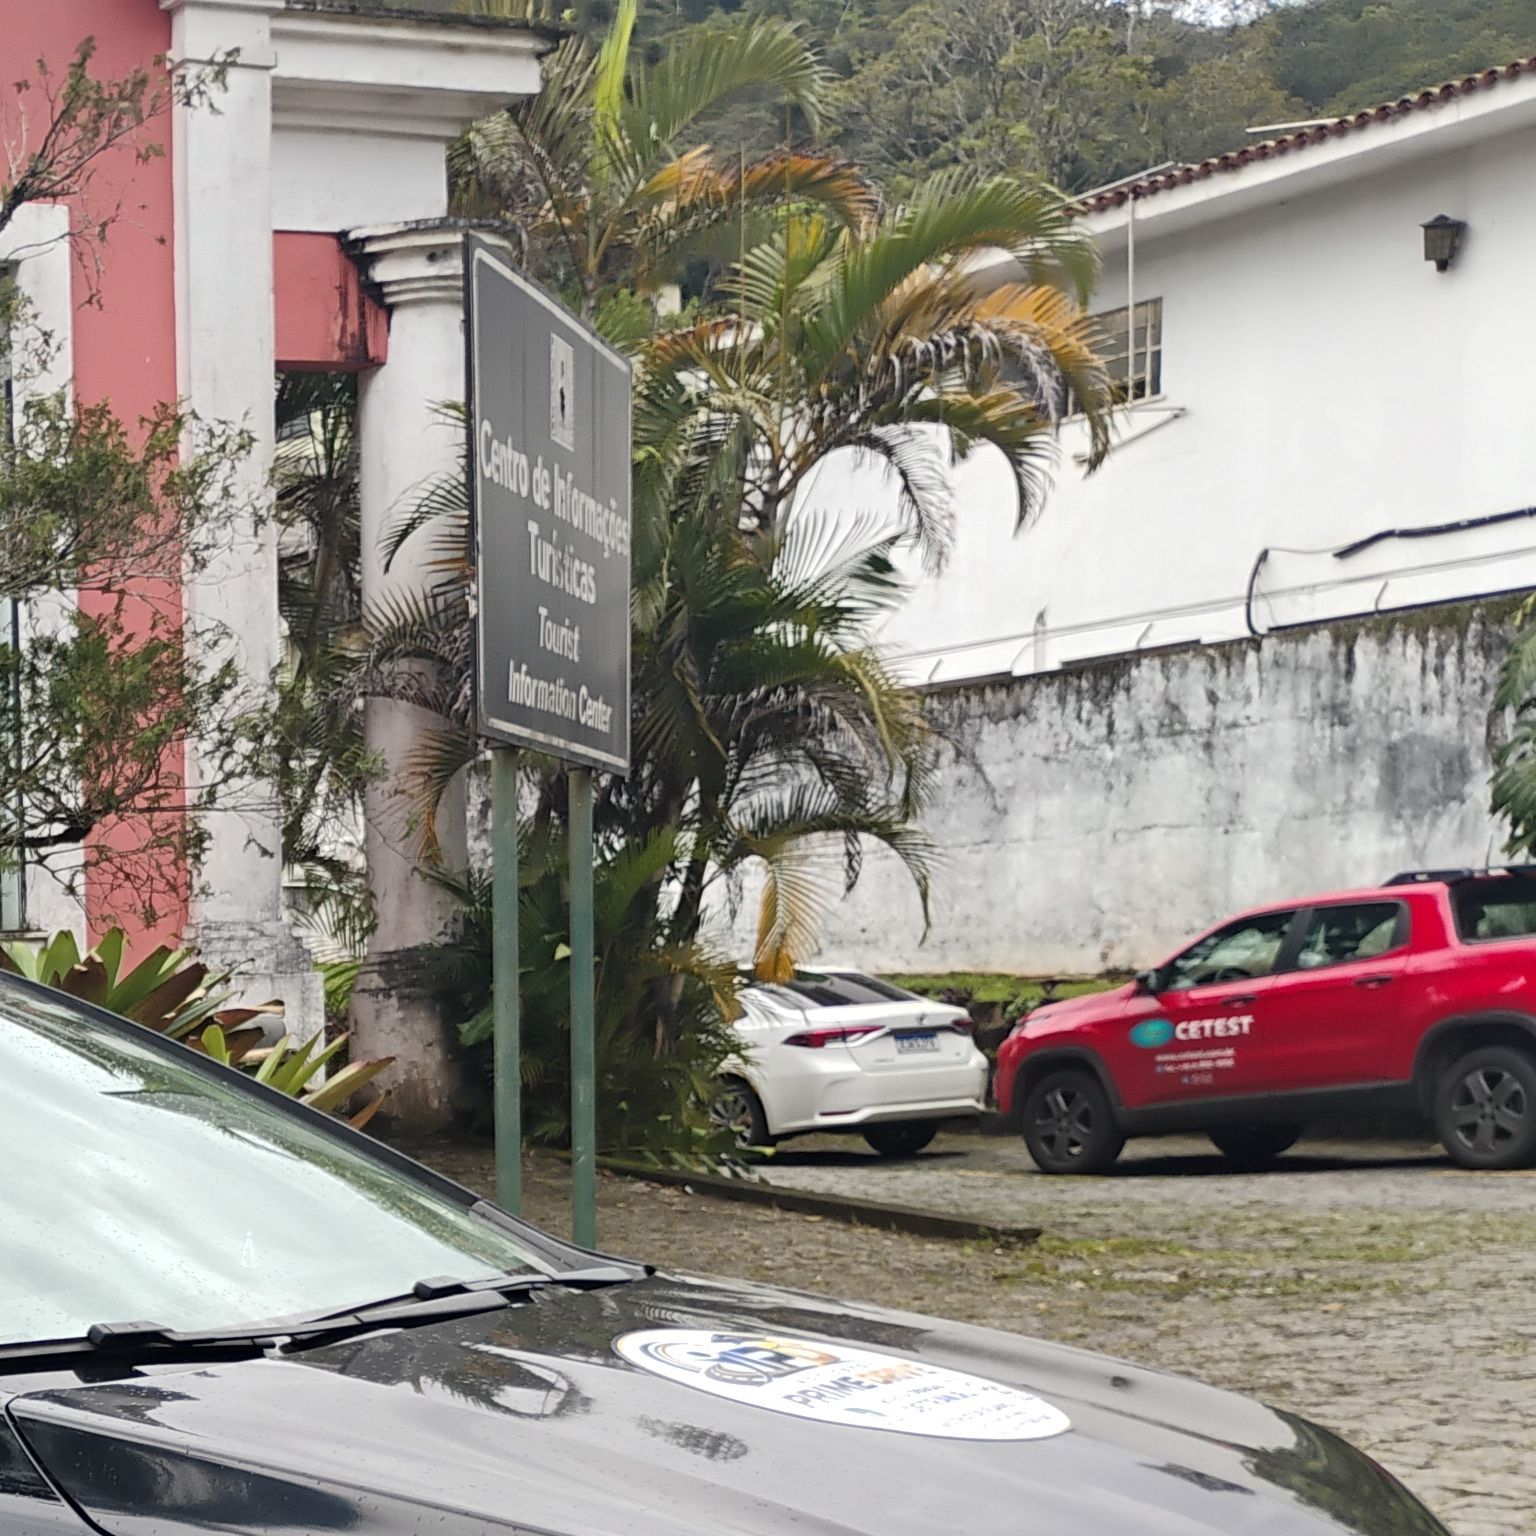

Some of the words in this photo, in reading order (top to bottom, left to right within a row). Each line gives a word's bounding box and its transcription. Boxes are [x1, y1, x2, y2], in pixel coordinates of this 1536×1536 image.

[480, 419, 530, 498] Centro
[532, 455, 551, 510] de
[554, 463, 629, 558] Informações
[538, 605, 580, 663] Tourist
[508, 659, 577, 721] Information
[578, 684, 613, 733] Center
[1175, 1015, 1254, 1040] CETEST
[782, 1376, 878, 1409] PRIME
